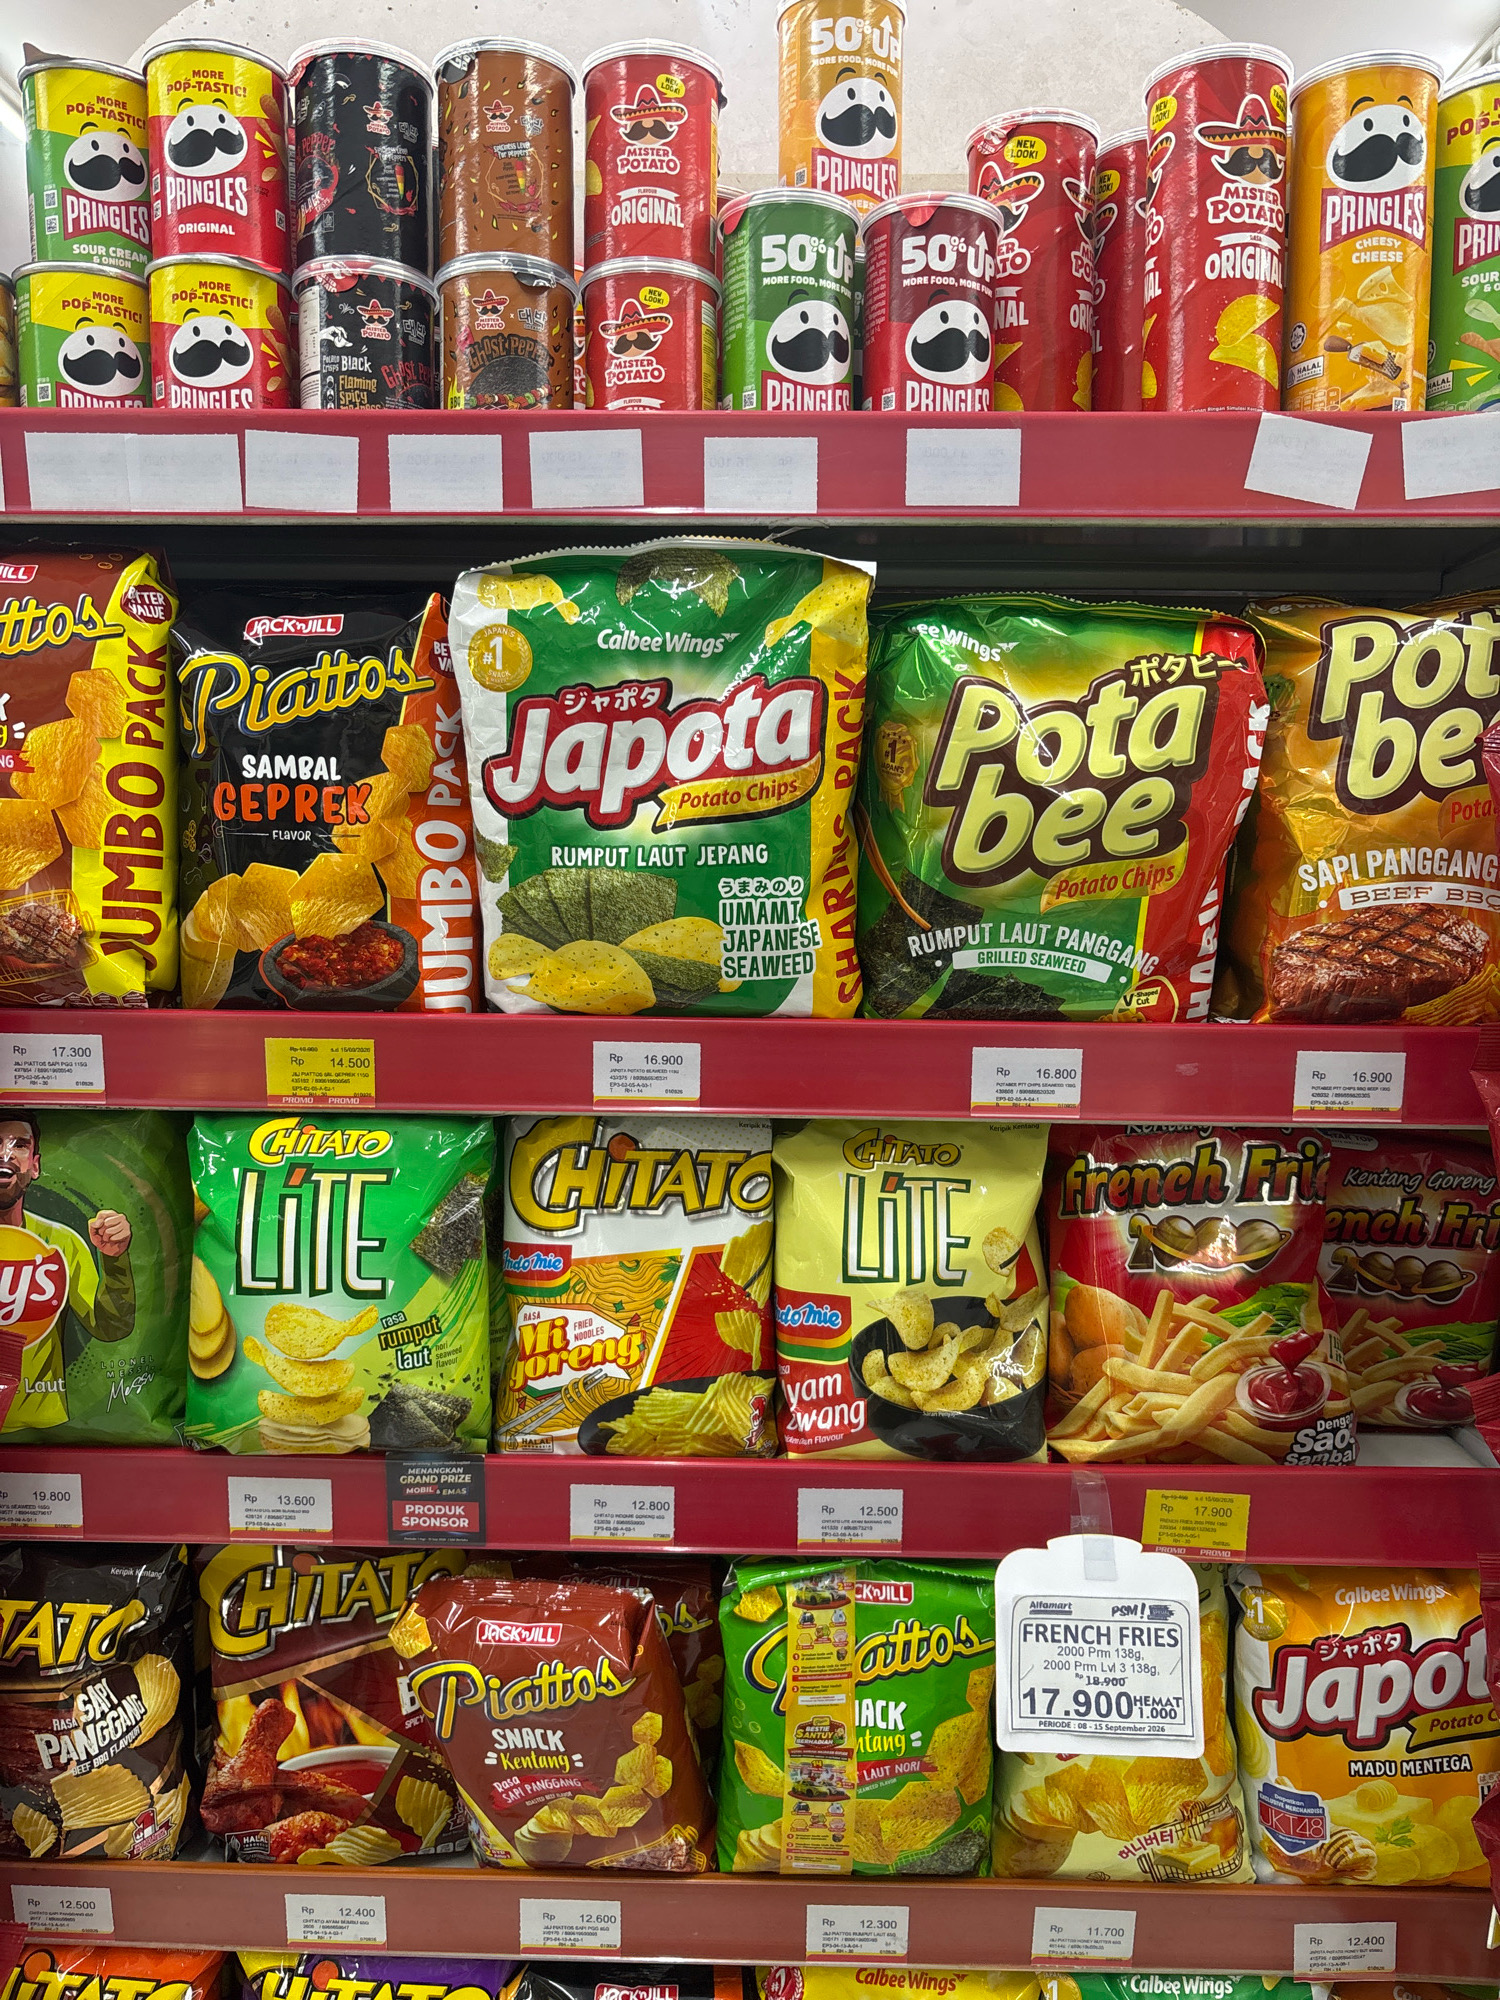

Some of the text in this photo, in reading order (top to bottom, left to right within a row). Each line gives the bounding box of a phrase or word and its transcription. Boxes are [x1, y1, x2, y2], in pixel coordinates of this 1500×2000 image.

[192, 69, 224, 80] MORE
[96, 95, 128, 111] MORE
[627, 148, 670, 157] MISTER
[618, 158, 679, 172] POTATO
[816, 155, 897, 202] PRINGLES
[166, 176, 248, 217] PRINGLES
[1224, 187, 1280, 205] MISTER
[66, 195, 150, 245] PRINGLES
[611, 198, 685, 228] ORIGINAL
[1210, 200, 1285, 228] POTATO
[1325, 193, 1425, 244] PRINGLES
[178, 222, 236, 236] ORIGINAL
[72, 244, 148, 264] SOUR CREAM
[1355, 237, 1402, 250] CHEESY
[93, 255, 132, 269] & ONION
[1204, 247, 1283, 287] ORIGINAL
[1352, 251, 1403, 264] CHEESE
[903, 276, 980, 291] MORE FOOD, MORE
[614, 359, 654, 369] MISTER
[1297, 360, 1322, 374] HALAL
[606, 369, 664, 384] POTATO
[597, 628, 725, 659] Calbee Wings
[1130, 654, 1247, 689] ポタビー
[126, 639, 166, 749] PACK
[178, 647, 437, 759] Piattos
[563, 686, 661, 715] ジャポタ
[834, 670, 866, 790] PACK
[935, 679, 1207, 791] Pota
[427, 703, 463, 807] PACK
[493, 685, 815, 814] Japota
[242, 754, 342, 781] SAMBAL
[213, 783, 372, 825] GEPREK
[678, 779, 797, 810] Potato Chips
[952, 764, 1176, 873] bee
[100, 761, 165, 971] JUMBO
[551, 844, 769, 867] RUMPUT LAUT JEPANG
[1055, 864, 1176, 900] Potato Chips
[1297, 853, 1360, 891] SAPI
[720, 877, 802, 895] うまみのり
[1351, 886, 1433, 904] BEEF
[415, 820, 473, 1014] JUMBO
[722, 899, 801, 926] UMAMI
[724, 921, 820, 953] JAPANESE
[907, 923, 1160, 977] RUMPUT LAUT PANGGANG
[724, 952, 815, 979] SEAWEED
[977, 949, 1087, 974] GRILLED SEAWEED
[13, 1046, 91, 1057] Rp 17.300
[290, 1056, 370, 1068] Rp 14.500
[610, 1053, 684, 1065] Rp 16.900
[997, 1067, 1077, 1079] Rp 16.800
[1312, 1071, 1393, 1083] Rp 16.900
[1063, 1139, 1231, 1216] French
[1344, 1168, 1496, 1196] Kentang Goreng
[381, 1311, 406, 1330] rasa
[524, 1311, 541, 1321] RASA
[574, 1318, 593, 1331] FRIED
[379, 1315, 440, 1350] rumput
[519, 1317, 567, 1356] Mi
[574, 1326, 605, 1342] NOODLES
[396, 1348, 431, 1370] laut
[510, 1331, 645, 1391] goreng
[24, 1378, 66, 1393] Laut
[400, 1474, 472, 1484] GRAND PRIZE
[408, 1467, 464, 1475] MENANGKAN
[32, 1491, 71, 1501] 19.800
[244, 1493, 316, 1506] Rp 13.600
[593, 1499, 670, 1511] Rp 12.800
[405, 1504, 465, 1515] PRODUK
[821, 1505, 899, 1517] Rp 12.500
[1160, 1503, 1233, 1518] Rp 17.900
[401, 1516, 469, 1527] SPONSOR
[1335, 1583, 1445, 1606] Calbee Wings
[1029, 1601, 1073, 1611] Alfamart
[1023, 1624, 1179, 1648] FRENCH FRIES
[1320, 1632, 1401, 1661] ジャポタ
[1057, 1646, 1145, 1661] 2000 Prm 138g,
[1043, 1660, 1071, 1671] 2000
[1074, 1661, 1097, 1673] Prm
[1119, 1662, 1126, 1673] 3
[1131, 1663, 1160, 1676] 138g,
[1086, 1675, 1126, 1687] 18.900
[77, 1678, 119, 1722] SAPI
[409, 1657, 635, 1742] Piattos
[1022, 1687, 1133, 1719] 17.900
[1133, 1696, 1183, 1708] HEMAT
[53, 1717, 78, 1731] RASA
[1138, 1708, 1177, 1720] 1.000
[1429, 1716, 1484, 1733] Potato
[35, 1693, 147, 1769] PANGGANG
[1039, 1720, 1071, 1729] PERIODE
[1078, 1722, 1087, 1730] 08
[1105, 1724, 1145, 1733] September
[1147, 1725, 1166, 1733] 2026
[492, 1728, 565, 1752] SNACK
[500, 1751, 570, 1773] Kentang
[864, 1761, 921, 1782] LAUT NORI
[1350, 1755, 1471, 1777] MADU MENTEGA
[502, 1778, 581, 1803] SAPI PANGGANG
[1260, 1810, 1325, 1838] JKT48
[28, 1899, 96, 1910] Rp 12.500
[302, 1906, 376, 1917] Rp 12.400
[543, 1912, 617, 1924] Rp 12.600
[822, 1918, 898, 1929] Rp 12.300
[1050, 1924, 1125, 1937] Rp 11.700
[1309, 1936, 1385, 1947] Rp 12.400
[855, 1968, 957, 1995] Calbee Wings
[1130, 1975, 1233, 1998] Calbee Wings
